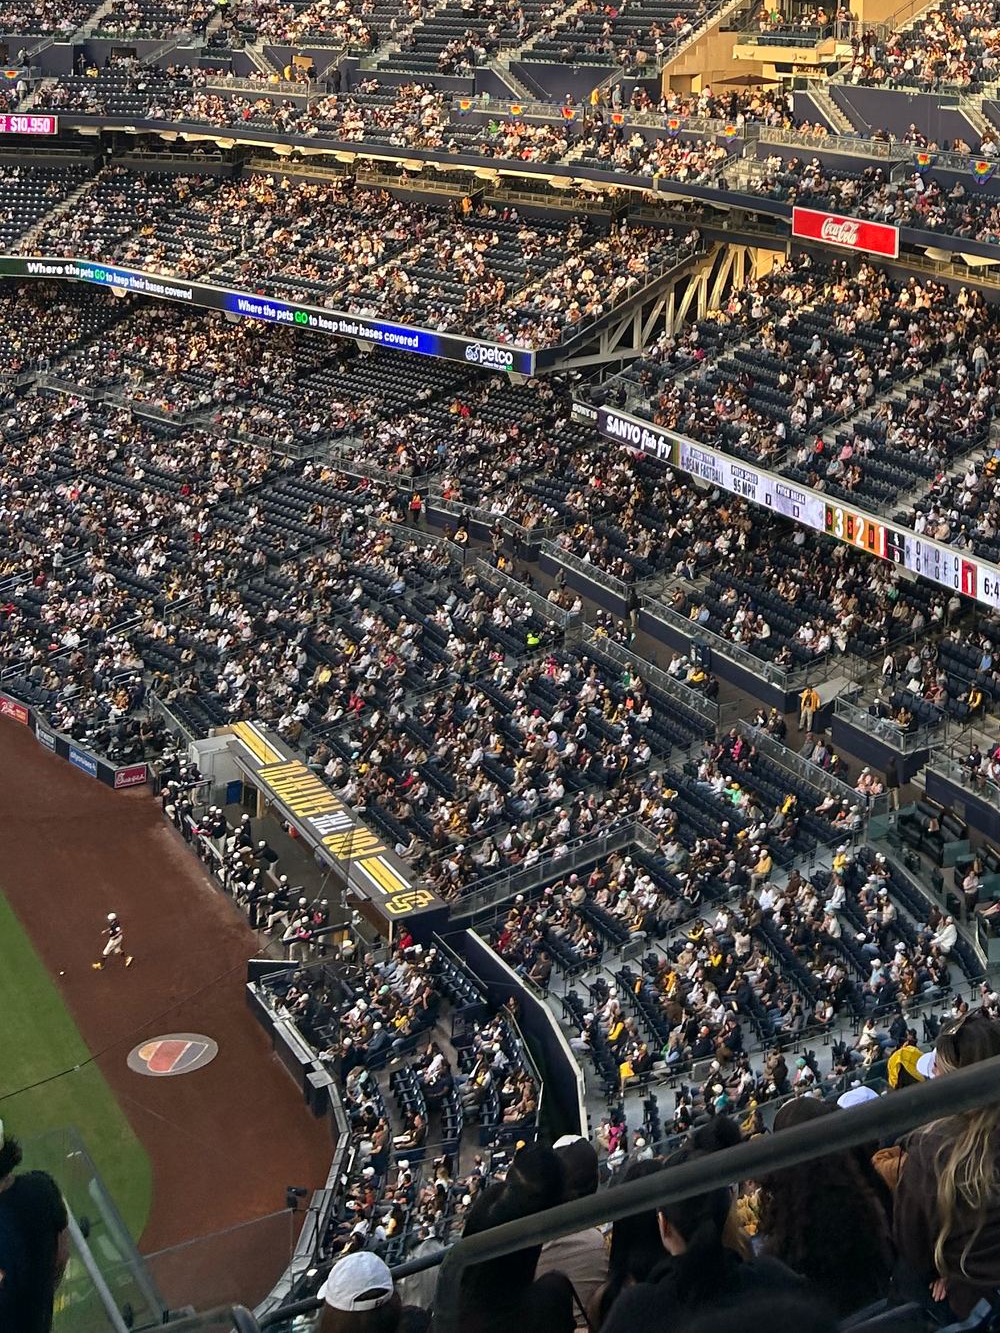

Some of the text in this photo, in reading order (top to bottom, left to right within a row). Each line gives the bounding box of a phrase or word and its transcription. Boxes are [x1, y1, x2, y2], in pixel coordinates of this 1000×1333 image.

[10, 116, 50, 133] $10,950
[27, 263, 193, 300] Where the pets GO to keep their bases covered
[238, 299, 418, 348] Where the pets GO to keep their bases covered
[480, 346, 513, 365] petco
[606, 415, 641, 444] SANYO
[641, 429, 657, 450] fish
[657, 435, 672, 459] fry
[700, 463, 724, 485] FASTBALL
[733, 478, 756, 499] 95 MPH
[835, 508, 843, 538] 3
[856, 517, 864, 548] 2
[879, 526, 885, 556] 1
[916, 541, 959, 571] 0 0 0
[916, 557, 959, 588] 0 0 0
[967, 572, 972, 594] 1
[256, 759, 387, 860] FOR THE FAITHFUL
